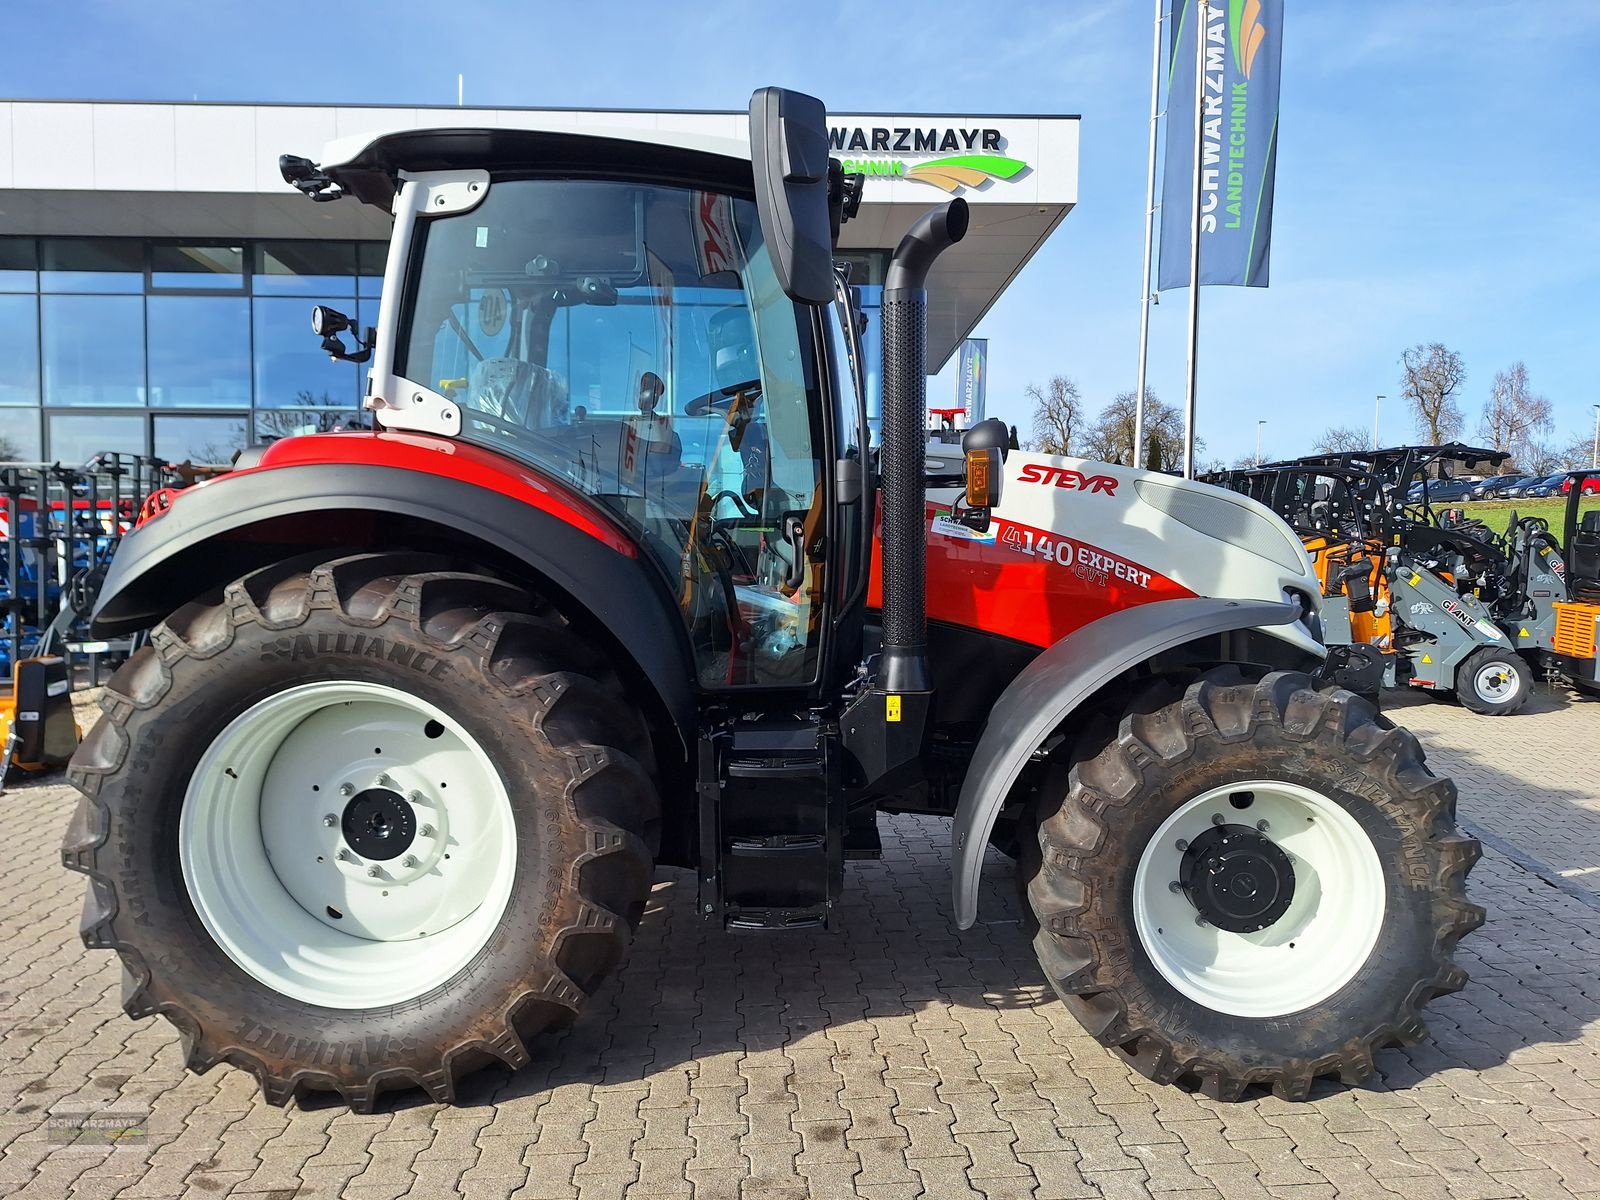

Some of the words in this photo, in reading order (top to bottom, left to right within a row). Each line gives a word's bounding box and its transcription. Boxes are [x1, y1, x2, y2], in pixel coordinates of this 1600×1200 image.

[828, 127, 1001, 152] WARZMAYR
[1200, 5, 1225, 234] SCHWARZMAY
[843, 159, 904, 177] CHNIK
[1225, 81, 1248, 229] LANDTECHNIK
[964, 357, 973, 424] SCHWARZMAYR
[1017, 463, 1119, 497] STEYR
[1002, 525, 1074, 567] 4140
[1077, 547, 1152, 589] EXPERT
[1074, 563, 1109, 587] CVT
[290, 633, 455, 682] ALLIANCE
[1334, 770, 1434, 893] ALLIANCE
[235, 1016, 390, 1065] ALLIANCE
